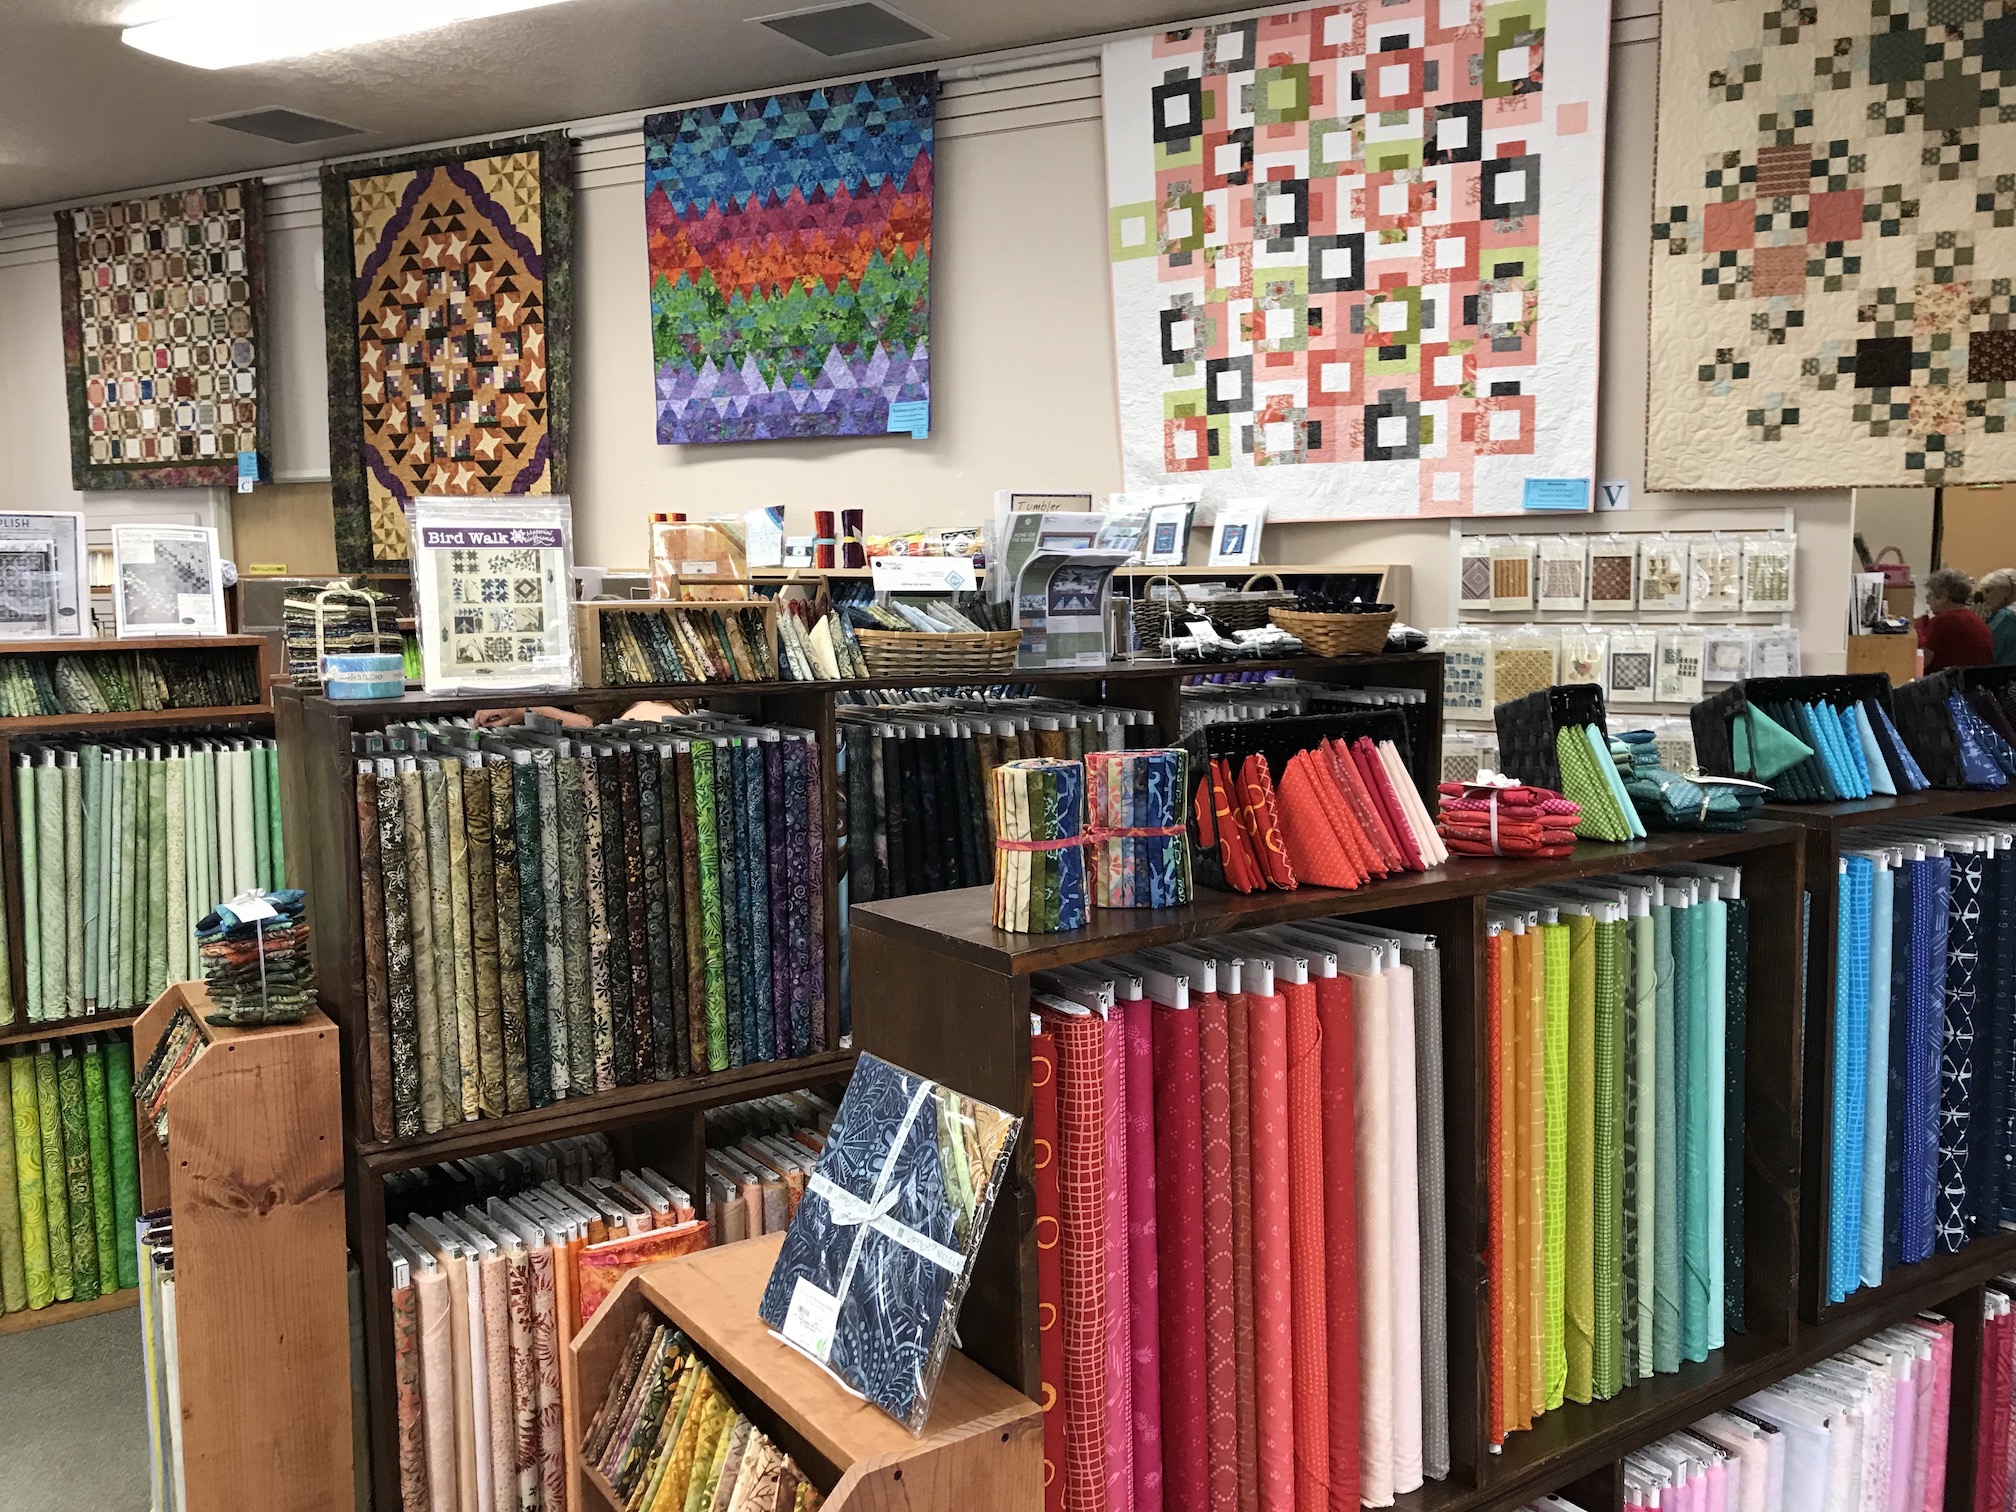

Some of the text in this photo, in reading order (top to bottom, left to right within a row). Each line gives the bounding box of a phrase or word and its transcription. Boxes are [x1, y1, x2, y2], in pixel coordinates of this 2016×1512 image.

[241, 480, 251, 491] C
[1601, 485, 1626, 507] V
[1017, 500, 1063, 511] Tumbler
[427, 531, 510, 544] Bird Walk
